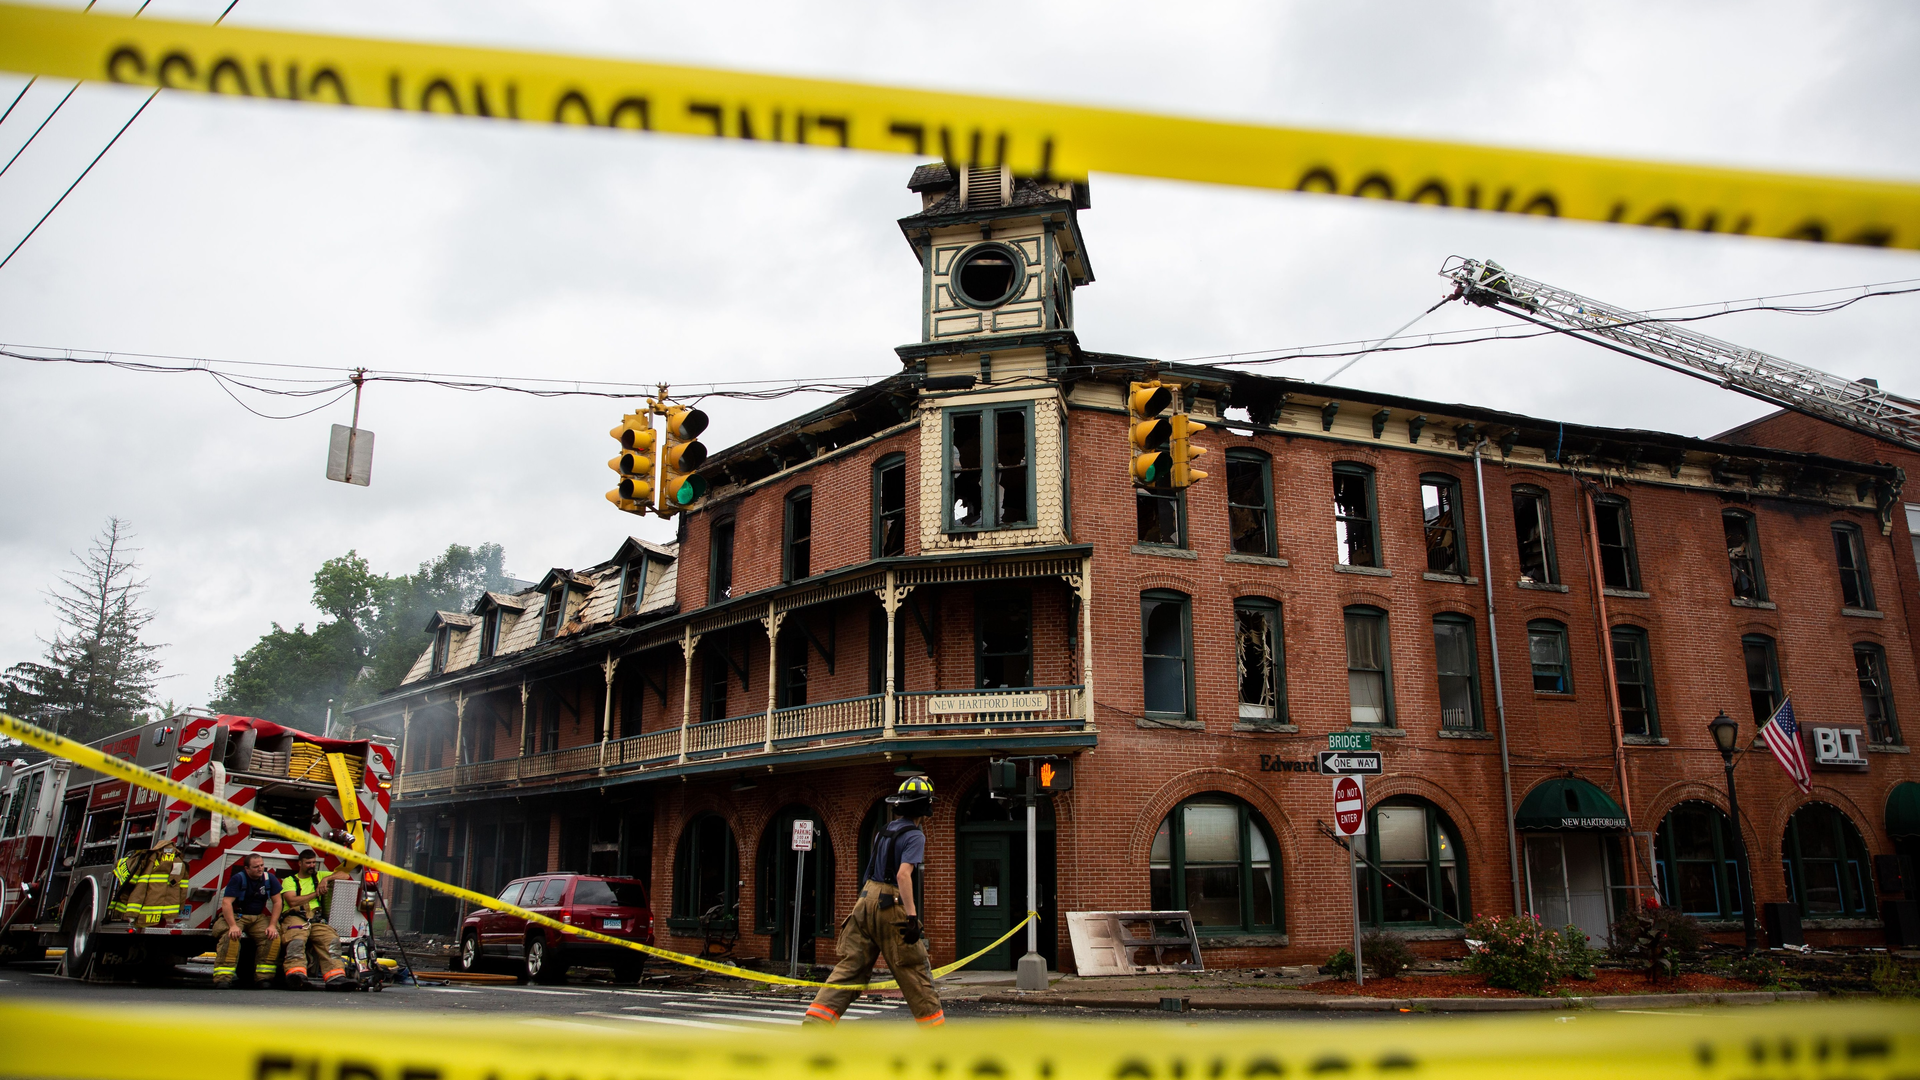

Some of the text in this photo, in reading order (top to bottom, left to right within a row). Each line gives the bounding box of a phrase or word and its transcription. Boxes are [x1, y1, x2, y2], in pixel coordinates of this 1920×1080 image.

[934, 697, 1043, 711] NEW HARTFORD HOUSE
[1329, 735, 1362, 749] BRIDGE
[1813, 727, 1862, 760] BLT
[1259, 754, 1319, 772] Edward
[1334, 758, 1375, 768] ONE WAY
[1337, 787, 1358, 799] DO NOT
[1340, 813, 1358, 824] ENTER
[1561, 817, 1580, 826] NEW
[1581, 817, 1614, 826] HARTFORD
